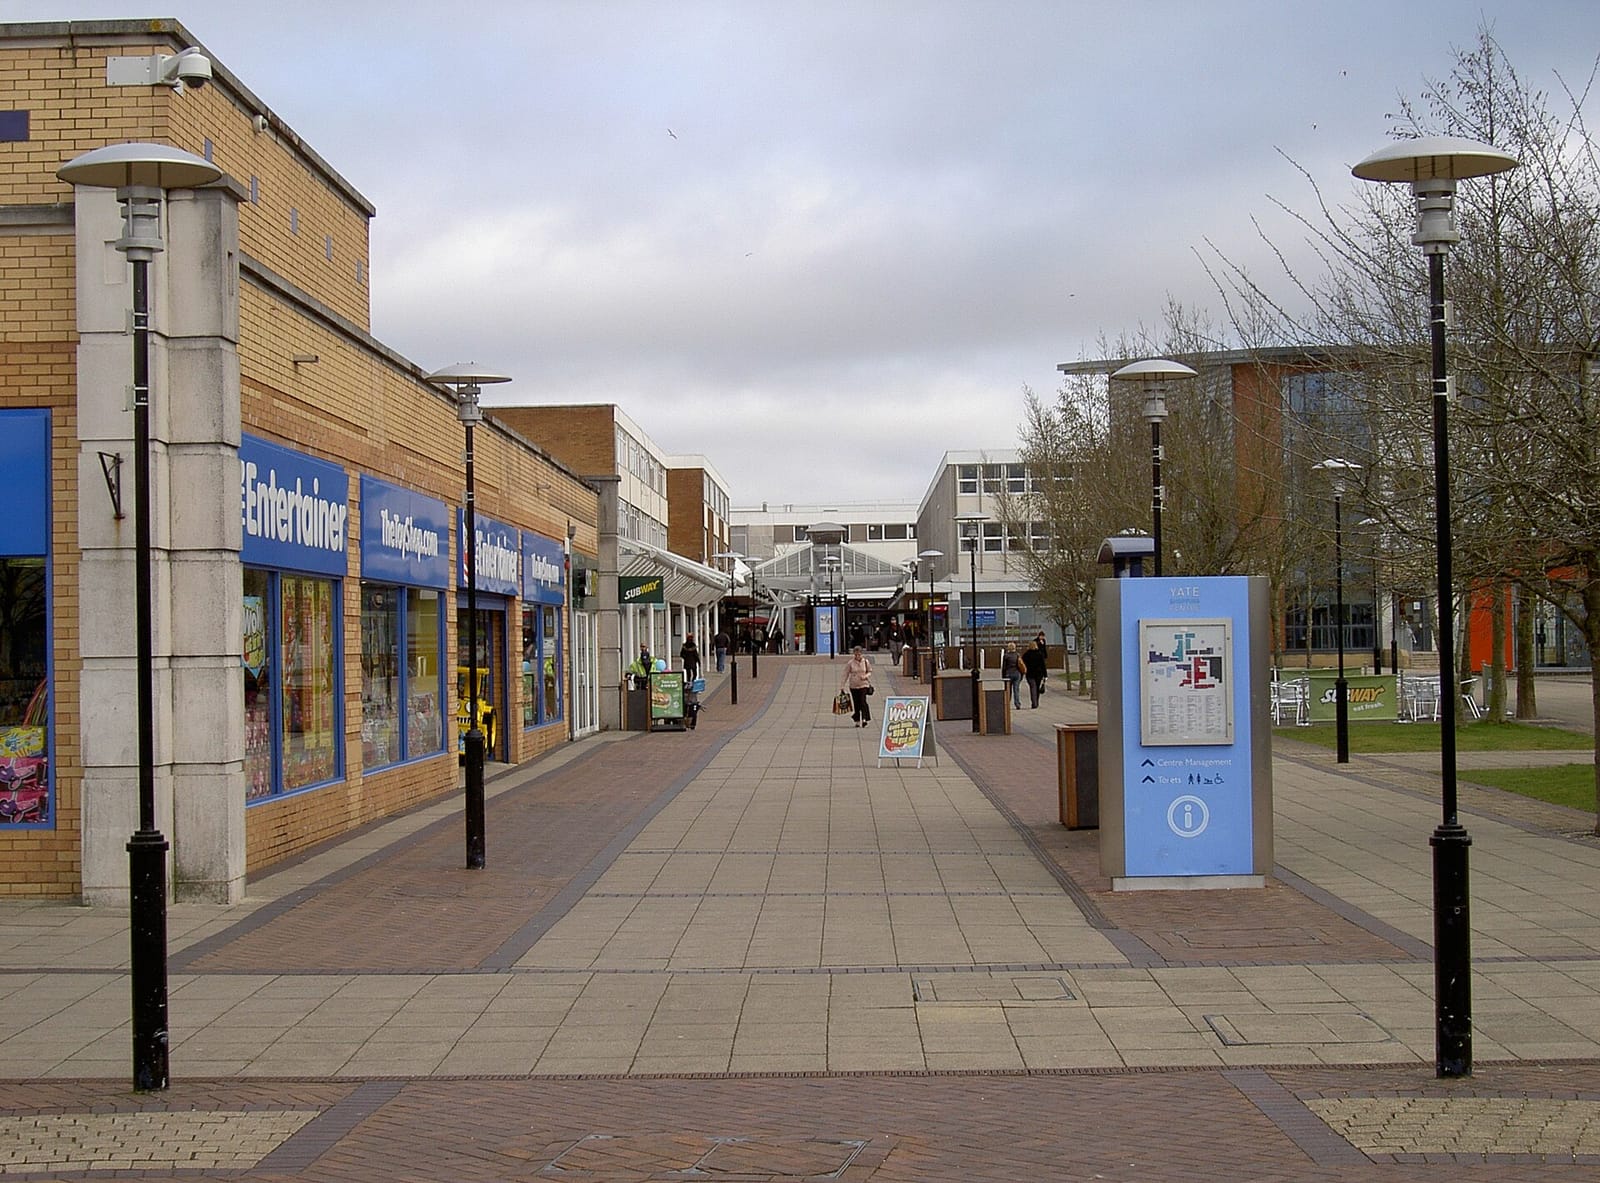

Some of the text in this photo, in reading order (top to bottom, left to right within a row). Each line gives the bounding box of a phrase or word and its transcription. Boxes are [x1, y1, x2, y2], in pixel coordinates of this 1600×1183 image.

[246, 461, 346, 552] Entertainer
[380, 508, 438, 563] TheToyShop.com
[478, 529, 518, 583] Entertainer
[624, 579, 660, 600] SUBWAY
[1169, 586, 1200, 597] YATE
[1157, 758, 1232, 768] Centre Management
